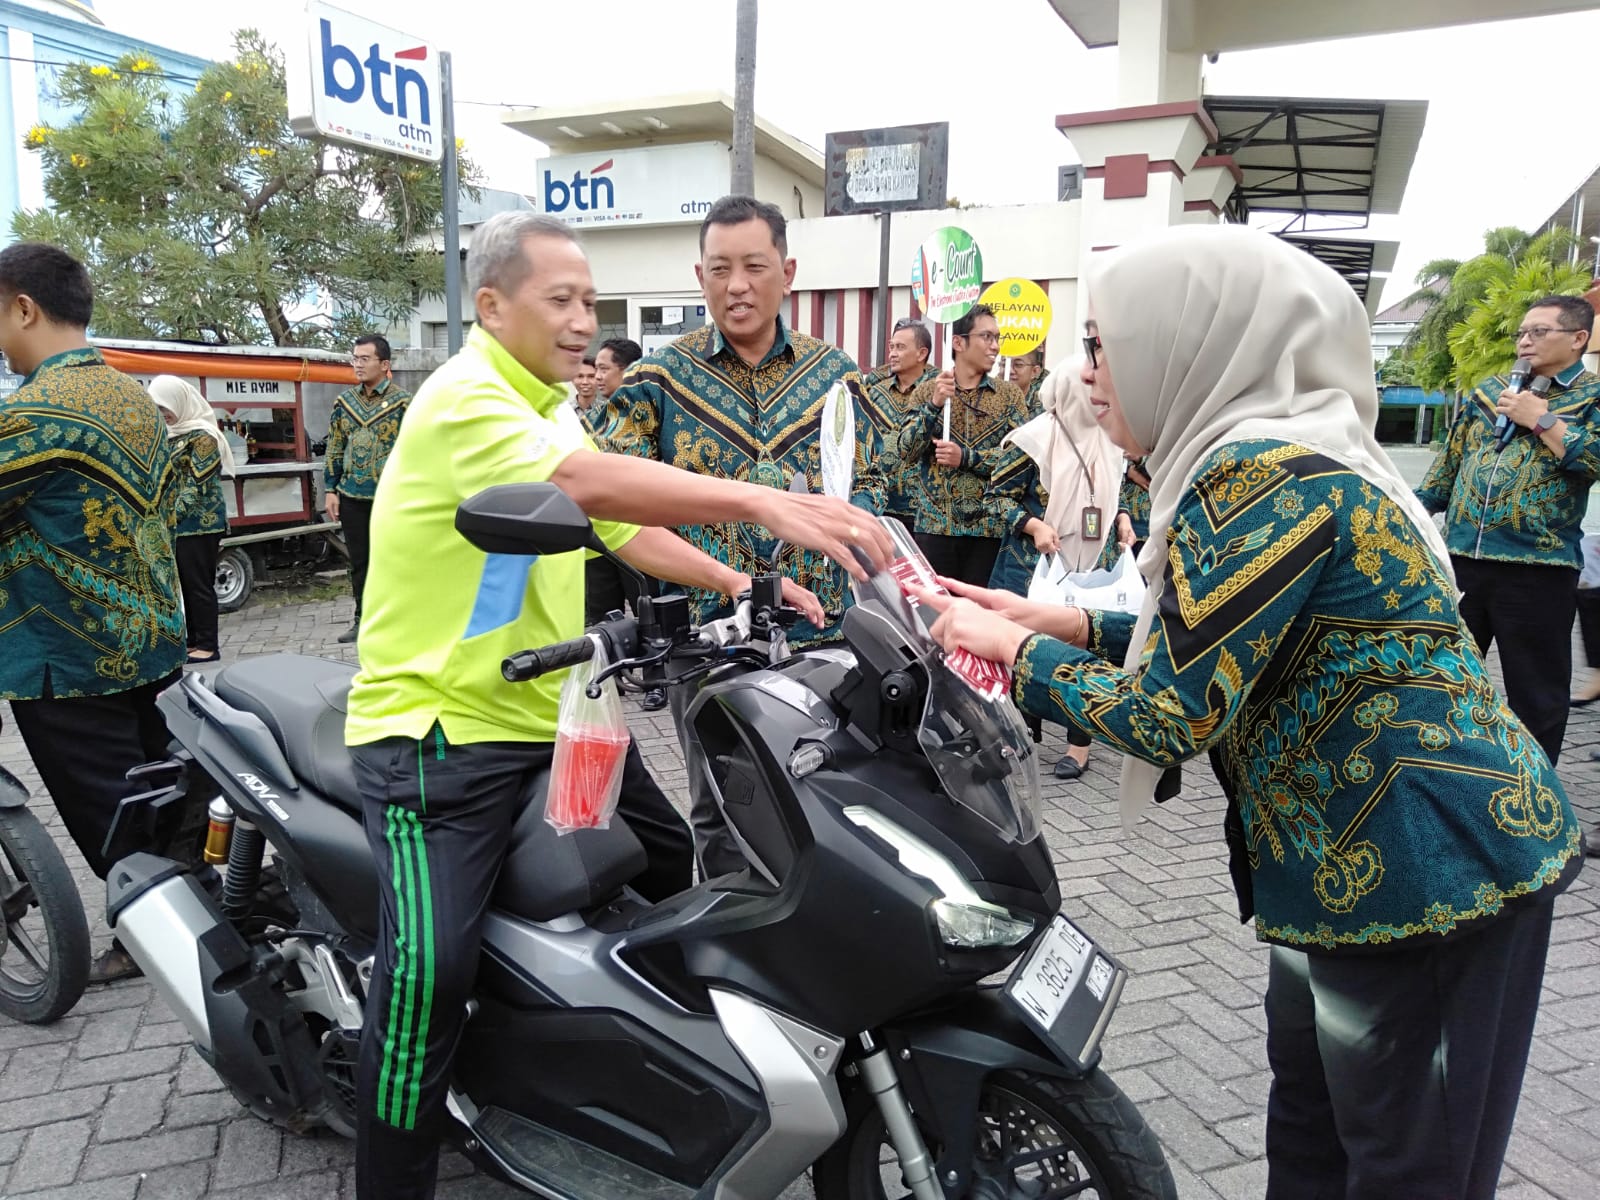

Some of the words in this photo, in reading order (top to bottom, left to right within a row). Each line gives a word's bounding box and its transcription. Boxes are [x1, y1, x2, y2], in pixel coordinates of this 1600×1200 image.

[320, 17, 431, 126] btn
[399, 123, 432, 144] atm
[544, 170, 614, 213] btn
[995, 316, 1043, 329] UKAN
[226, 381, 247, 394] MIE
[251, 382, 279, 393] AYAM
[236, 773, 281, 799] ADV
[1021, 990, 1049, 1021] W
[1036, 949, 1073, 998] 3625
[1058, 924, 1085, 955] DE
